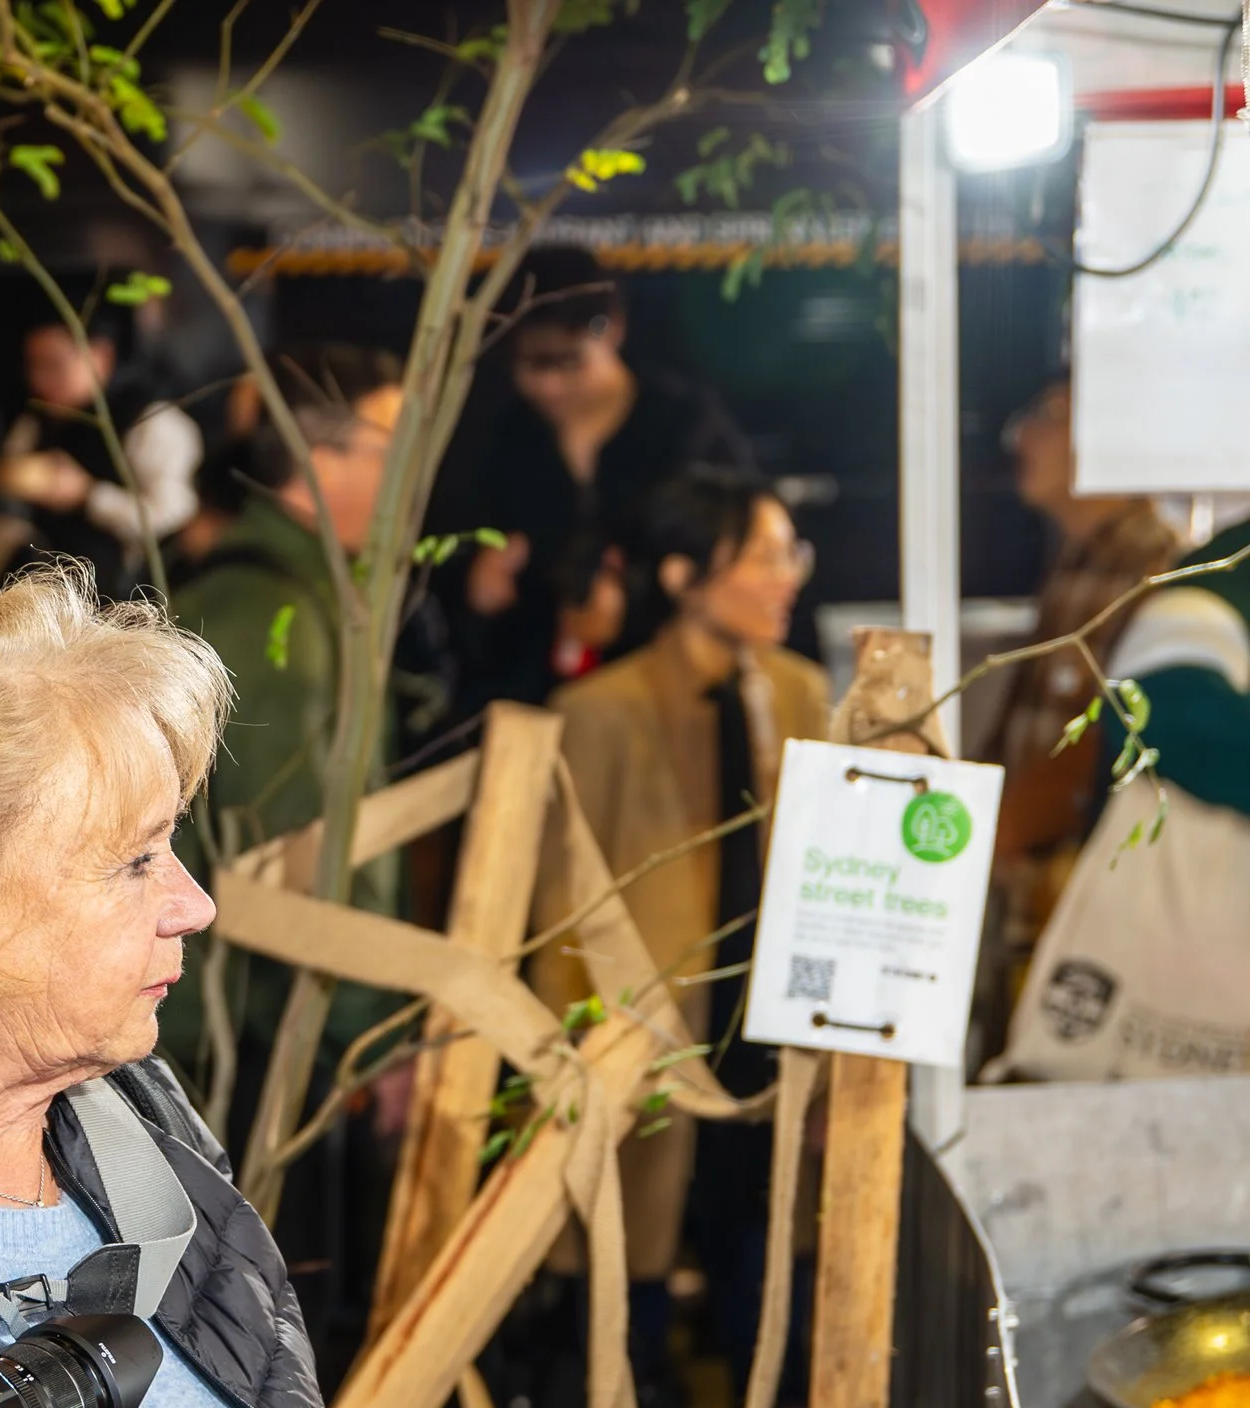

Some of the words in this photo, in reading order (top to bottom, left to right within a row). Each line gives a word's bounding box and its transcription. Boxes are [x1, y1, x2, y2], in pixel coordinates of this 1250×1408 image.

[804, 846, 899, 885] Sydney
[801, 881, 874, 910] street
[884, 891, 948, 920] trees
